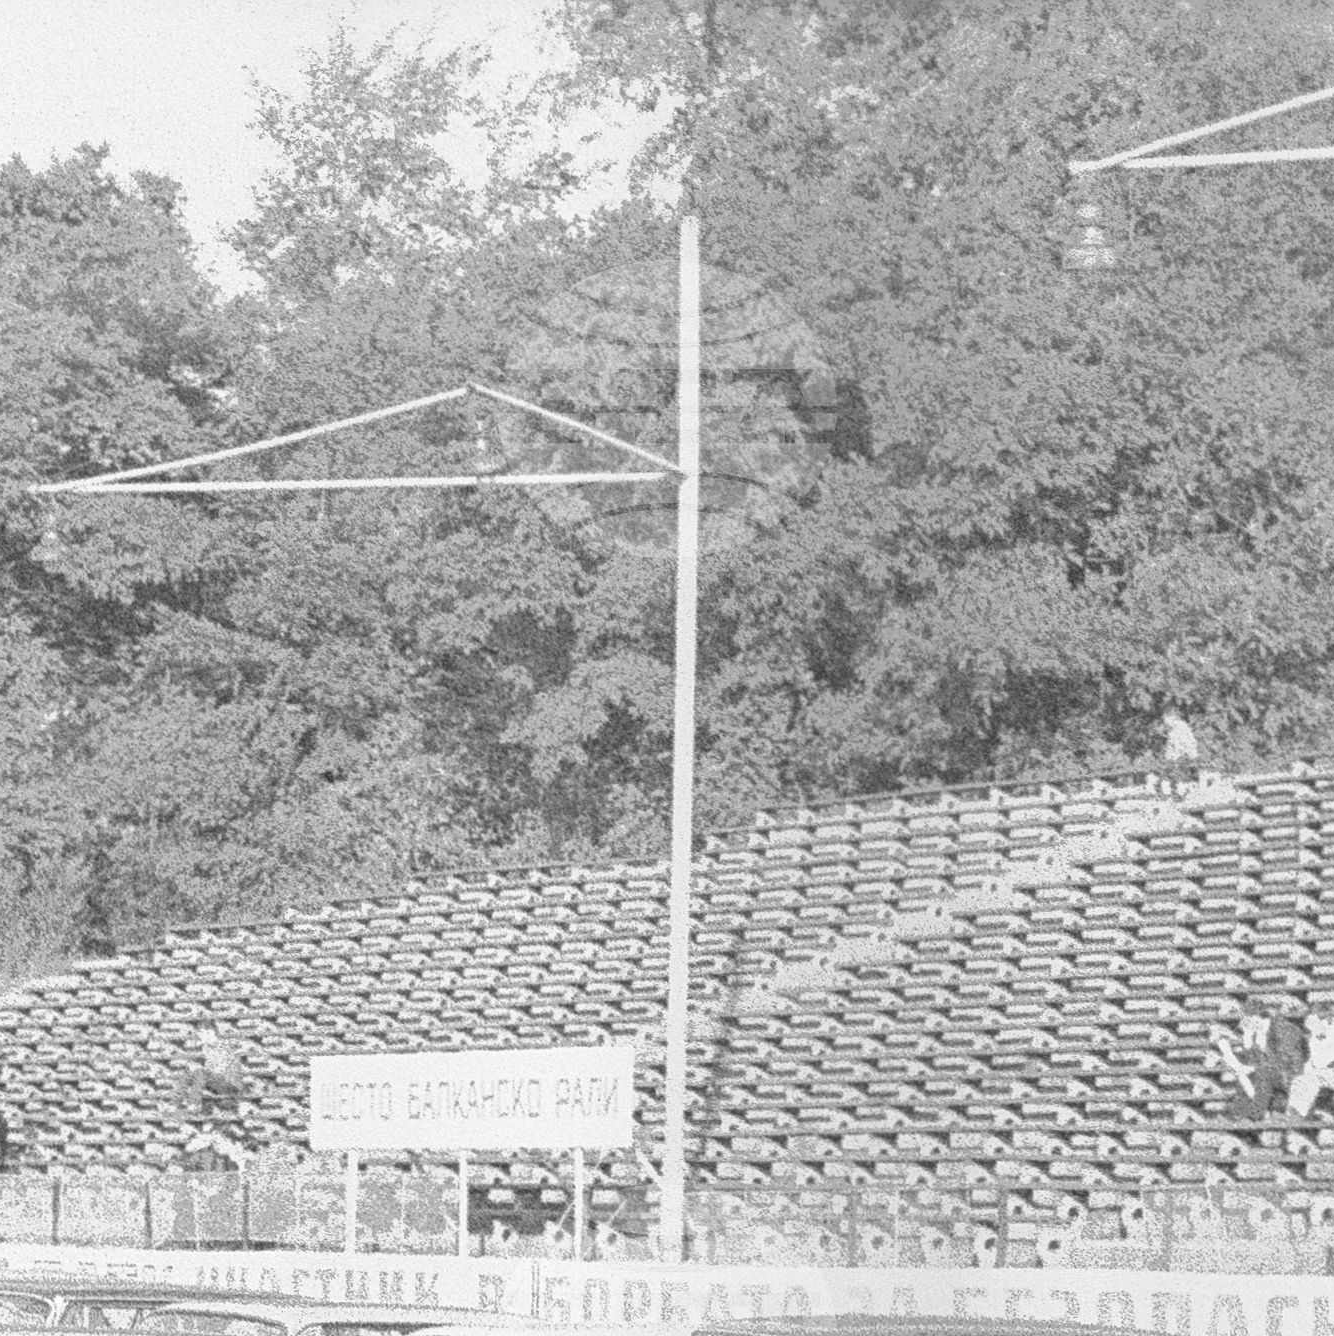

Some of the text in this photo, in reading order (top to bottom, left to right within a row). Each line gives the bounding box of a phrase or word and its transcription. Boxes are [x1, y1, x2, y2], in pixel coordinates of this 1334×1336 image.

[320, 1076, 619, 1122] ШЕСТО БАЛКАНСКО РАЛИ
